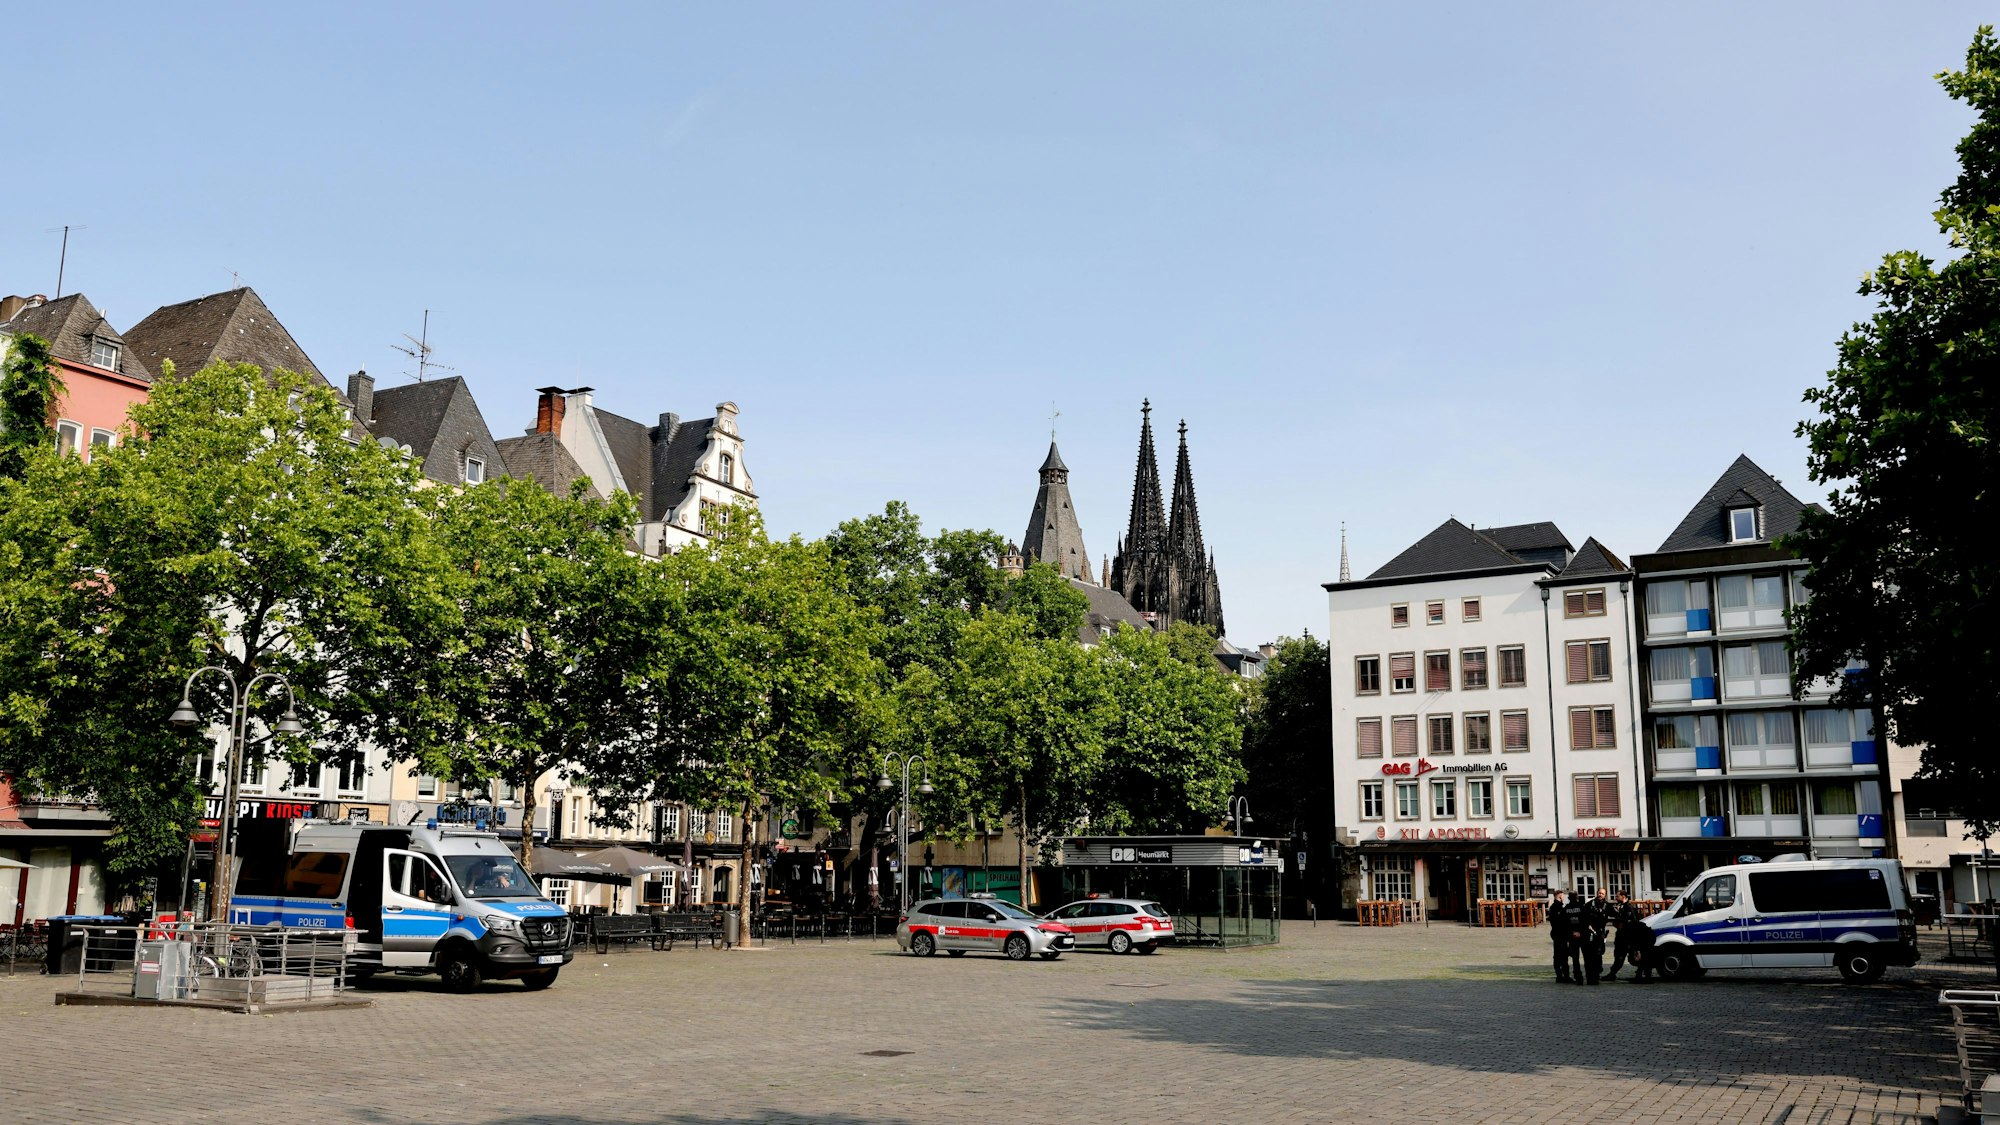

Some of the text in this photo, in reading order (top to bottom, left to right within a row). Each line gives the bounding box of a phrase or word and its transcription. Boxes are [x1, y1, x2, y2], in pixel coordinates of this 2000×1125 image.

[1381, 763, 1411, 776] GAG
[1442, 762, 1507, 773] Immobilien AG
[204, 799, 260, 819] HAPT
[1400, 828, 1420, 840] XII
[1427, 827, 1491, 840] APOSTEL
[1577, 828, 1620, 838] HOTEL
[989, 873, 1020, 882] SPIELHALL
[298, 917, 327, 927] POLIZEI
[1765, 930, 1804, 940] POLIZEI
